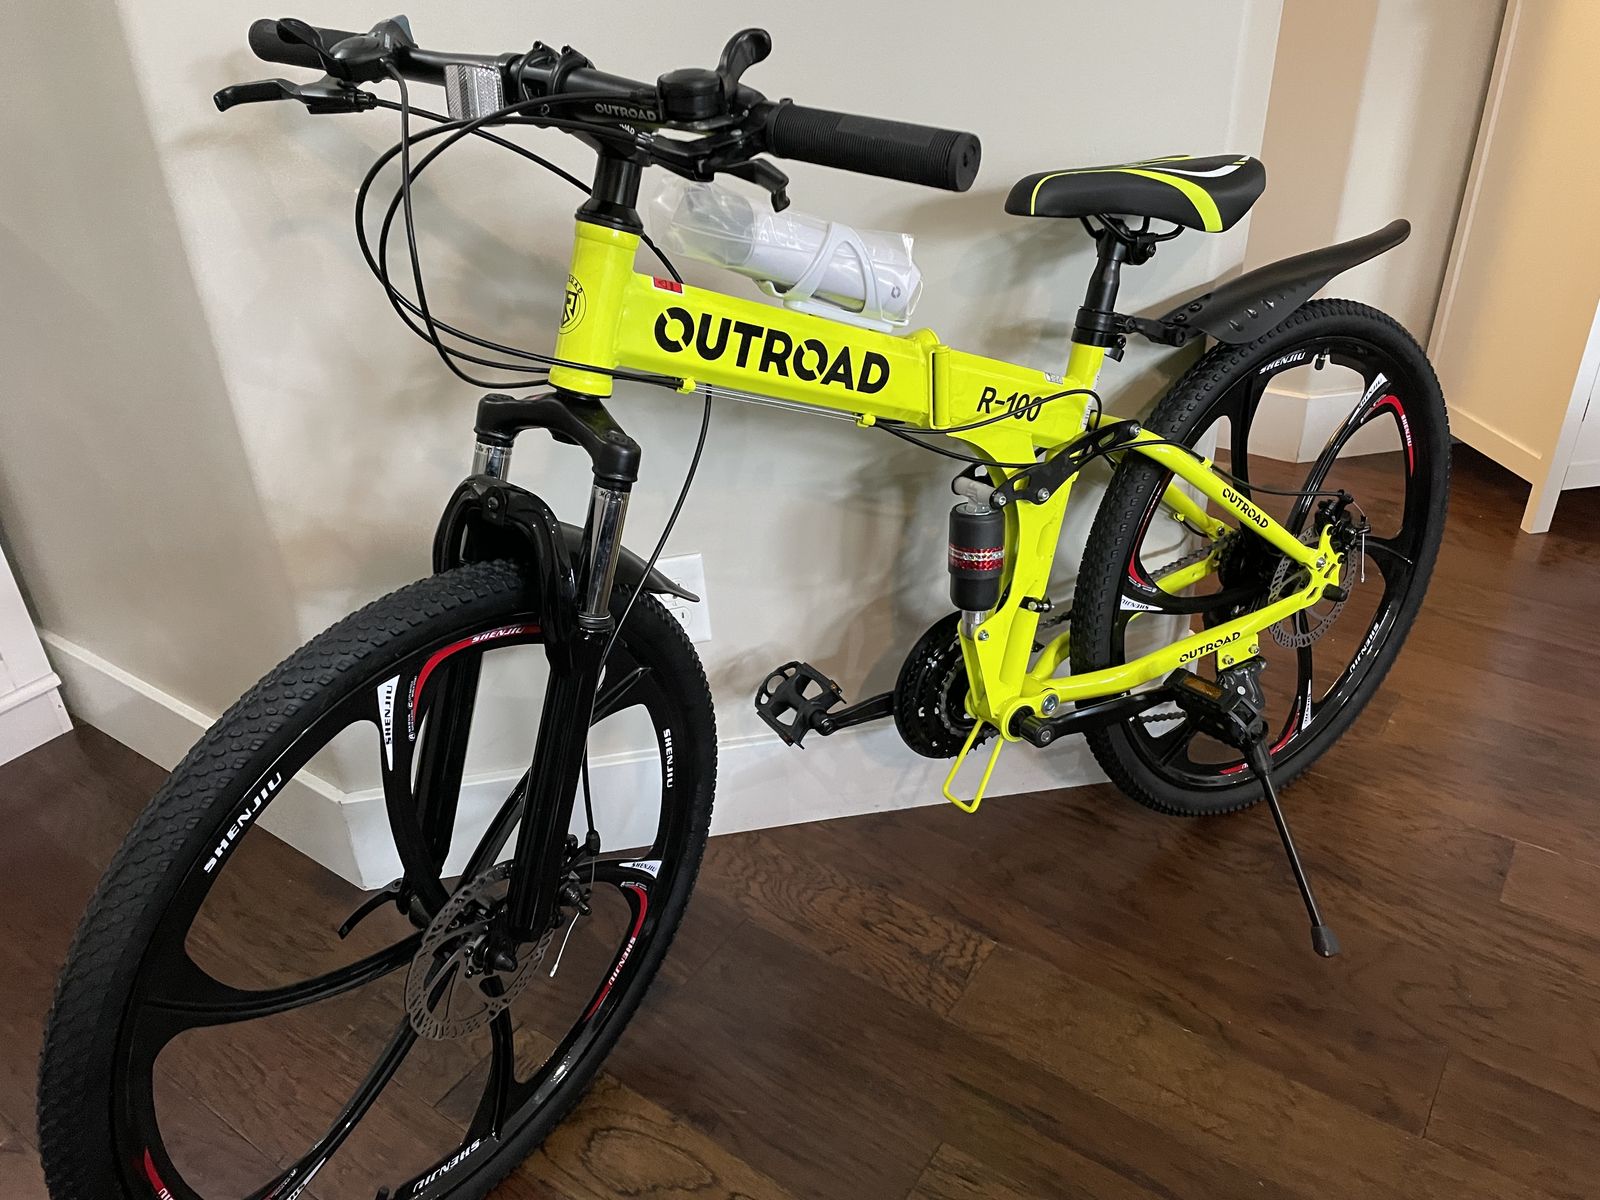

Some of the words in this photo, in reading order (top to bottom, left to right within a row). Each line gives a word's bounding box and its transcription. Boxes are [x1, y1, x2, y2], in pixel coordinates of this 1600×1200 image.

[595, 103, 657, 122] OUTROAD
[654, 306, 890, 394] OUTROAD
[1259, 351, 1306, 375] SHENJIU
[976, 386, 1043, 422] R-100
[1222, 487, 1269, 530] OUTROAD
[471, 626, 526, 644] SHENJIU
[1179, 631, 1241, 663] OUTROAD
[384, 685, 393, 745] SHENJIU
[662, 728, 674, 788] SHENJIU
[203, 771, 283, 874] SHENJIU
[608, 936, 636, 986] SHENJIU
[412, 1138, 481, 1193] SHENJIU
